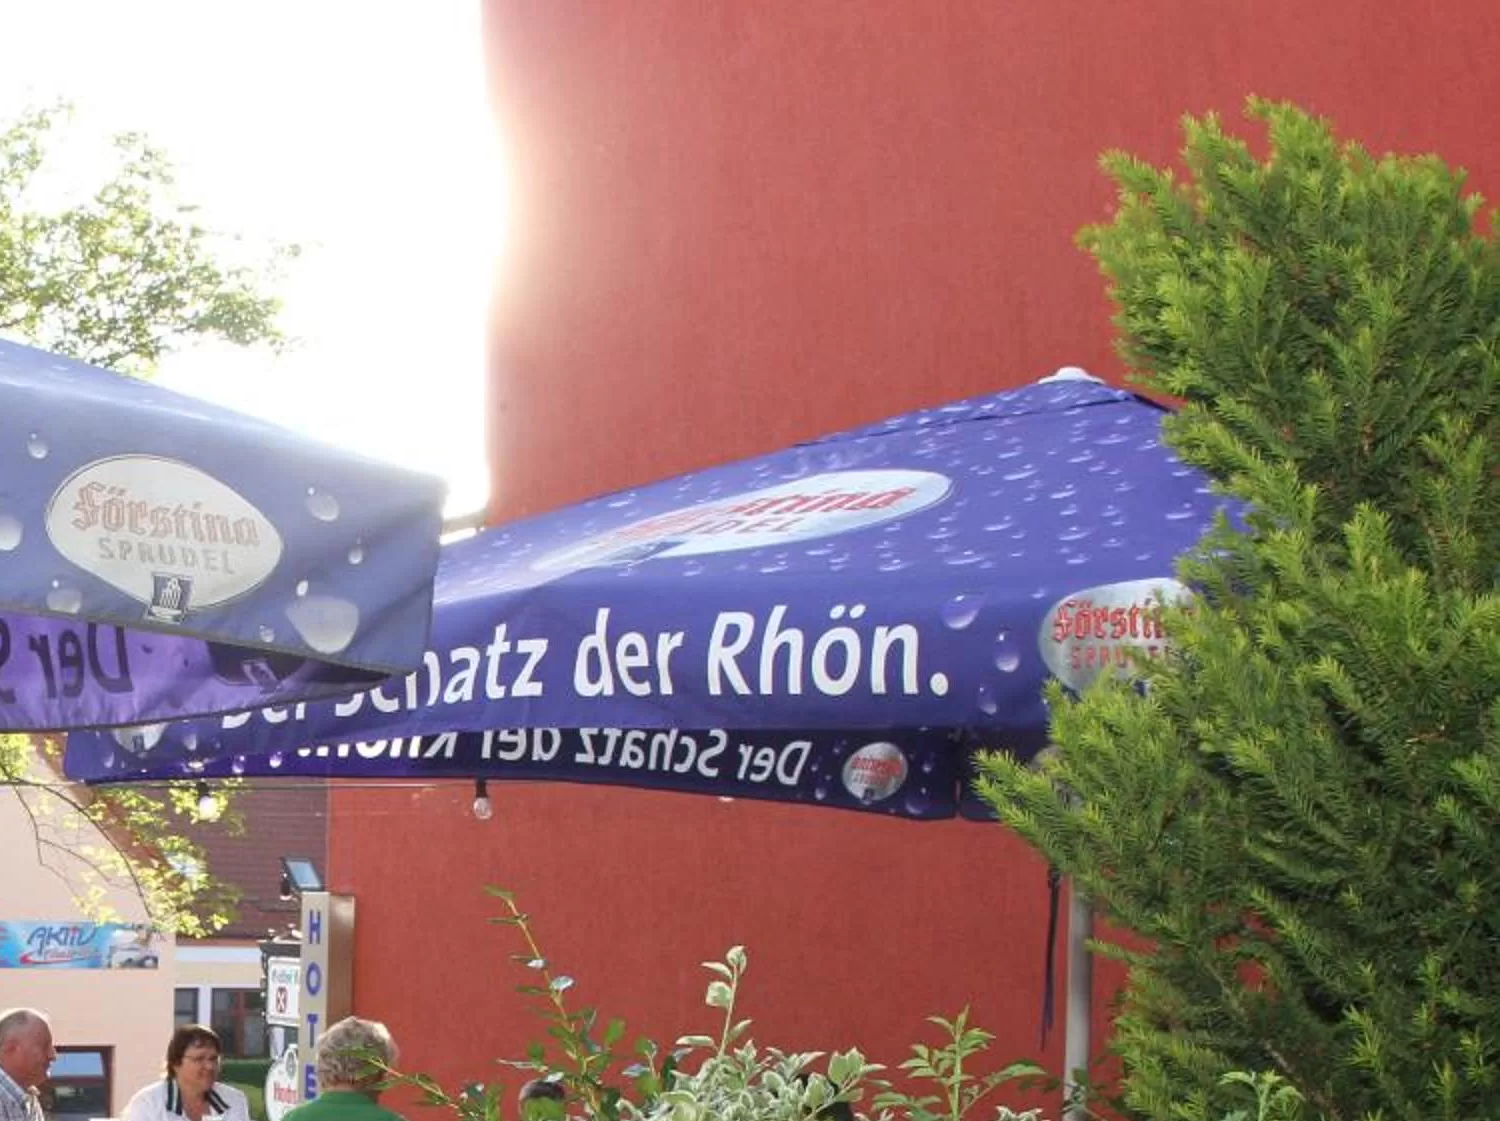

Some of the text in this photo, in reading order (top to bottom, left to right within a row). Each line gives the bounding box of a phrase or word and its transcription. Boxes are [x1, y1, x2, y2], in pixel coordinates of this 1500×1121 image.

[97, 537, 235, 575] SPRUDEL
[573, 607, 684, 699] der
[706, 604, 950, 697] Rhön.
[305, 909, 321, 1100] HOTE
